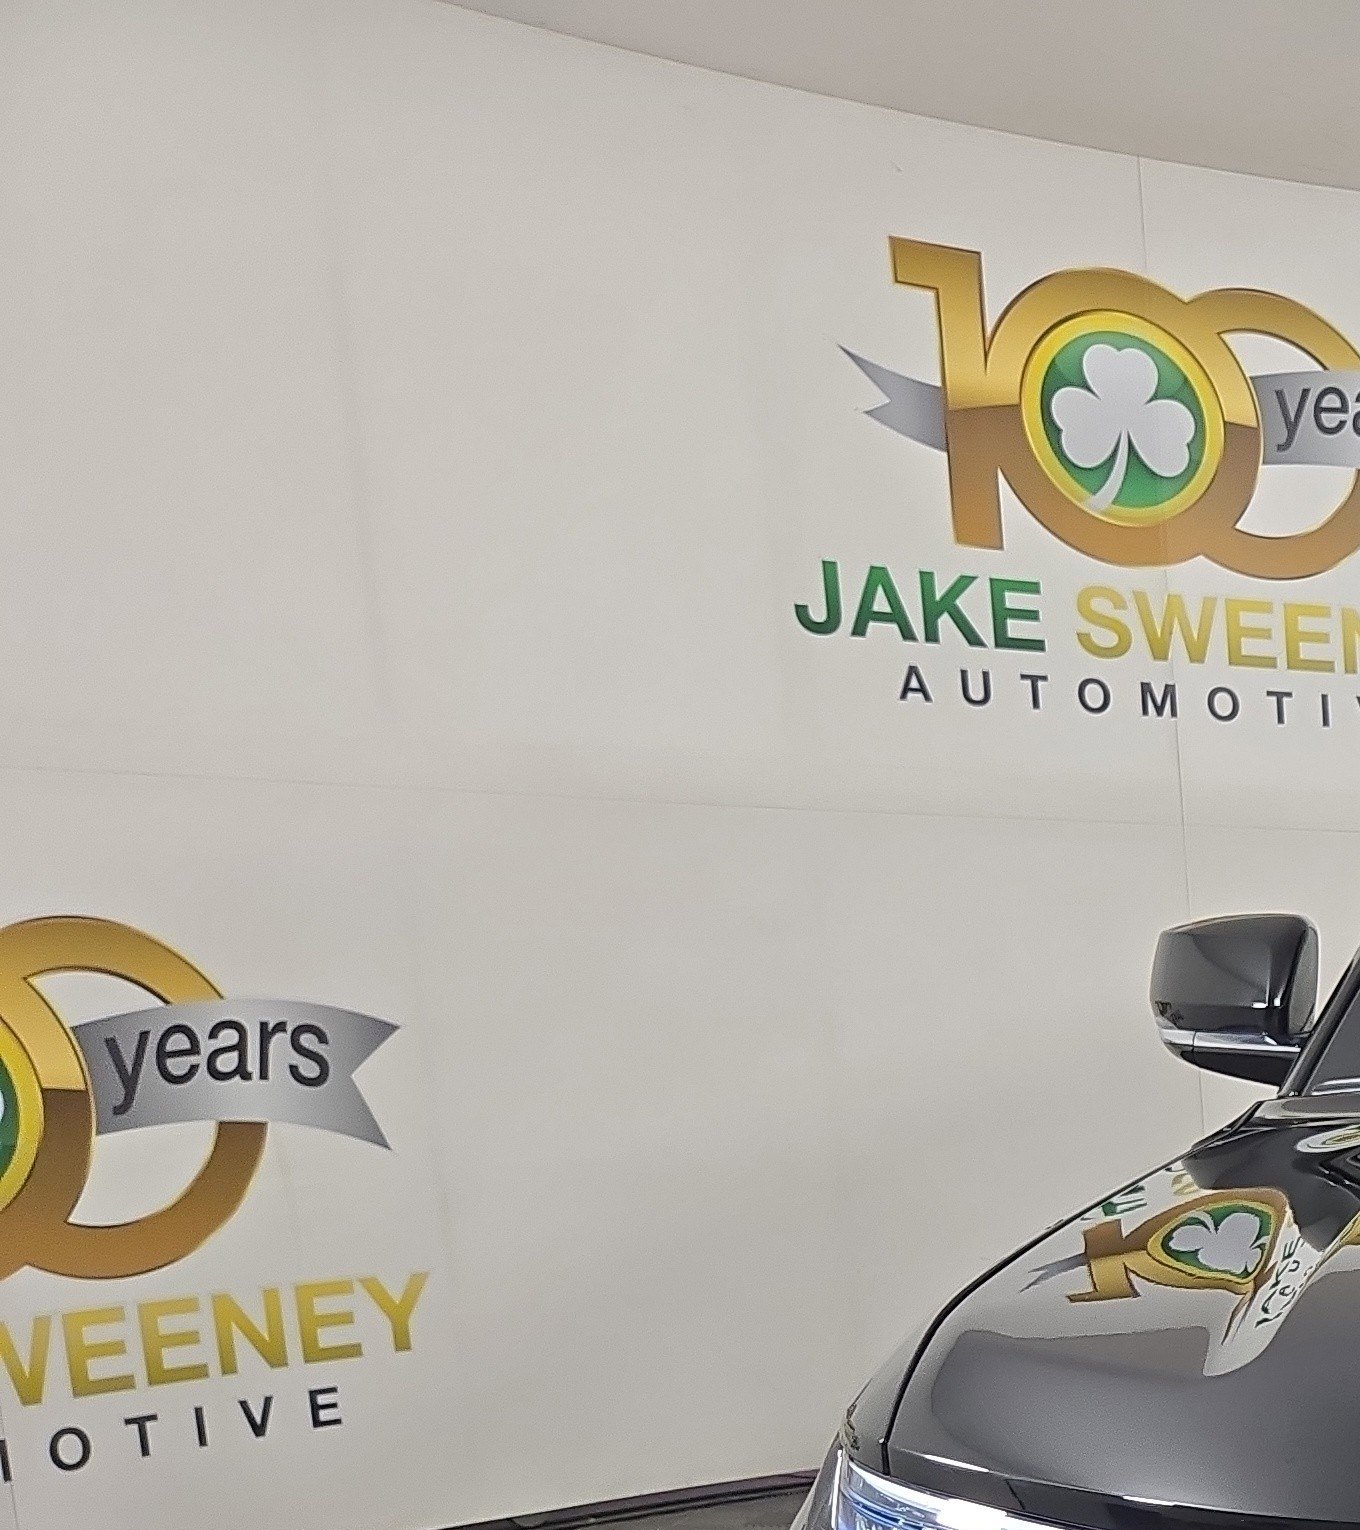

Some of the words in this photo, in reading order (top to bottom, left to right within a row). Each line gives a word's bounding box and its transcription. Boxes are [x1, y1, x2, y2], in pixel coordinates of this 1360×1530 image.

[794, 559, 1046, 653] JAKE
[104, 1019, 330, 1115] years
[0, 1387, 342, 1482] OTIVE
